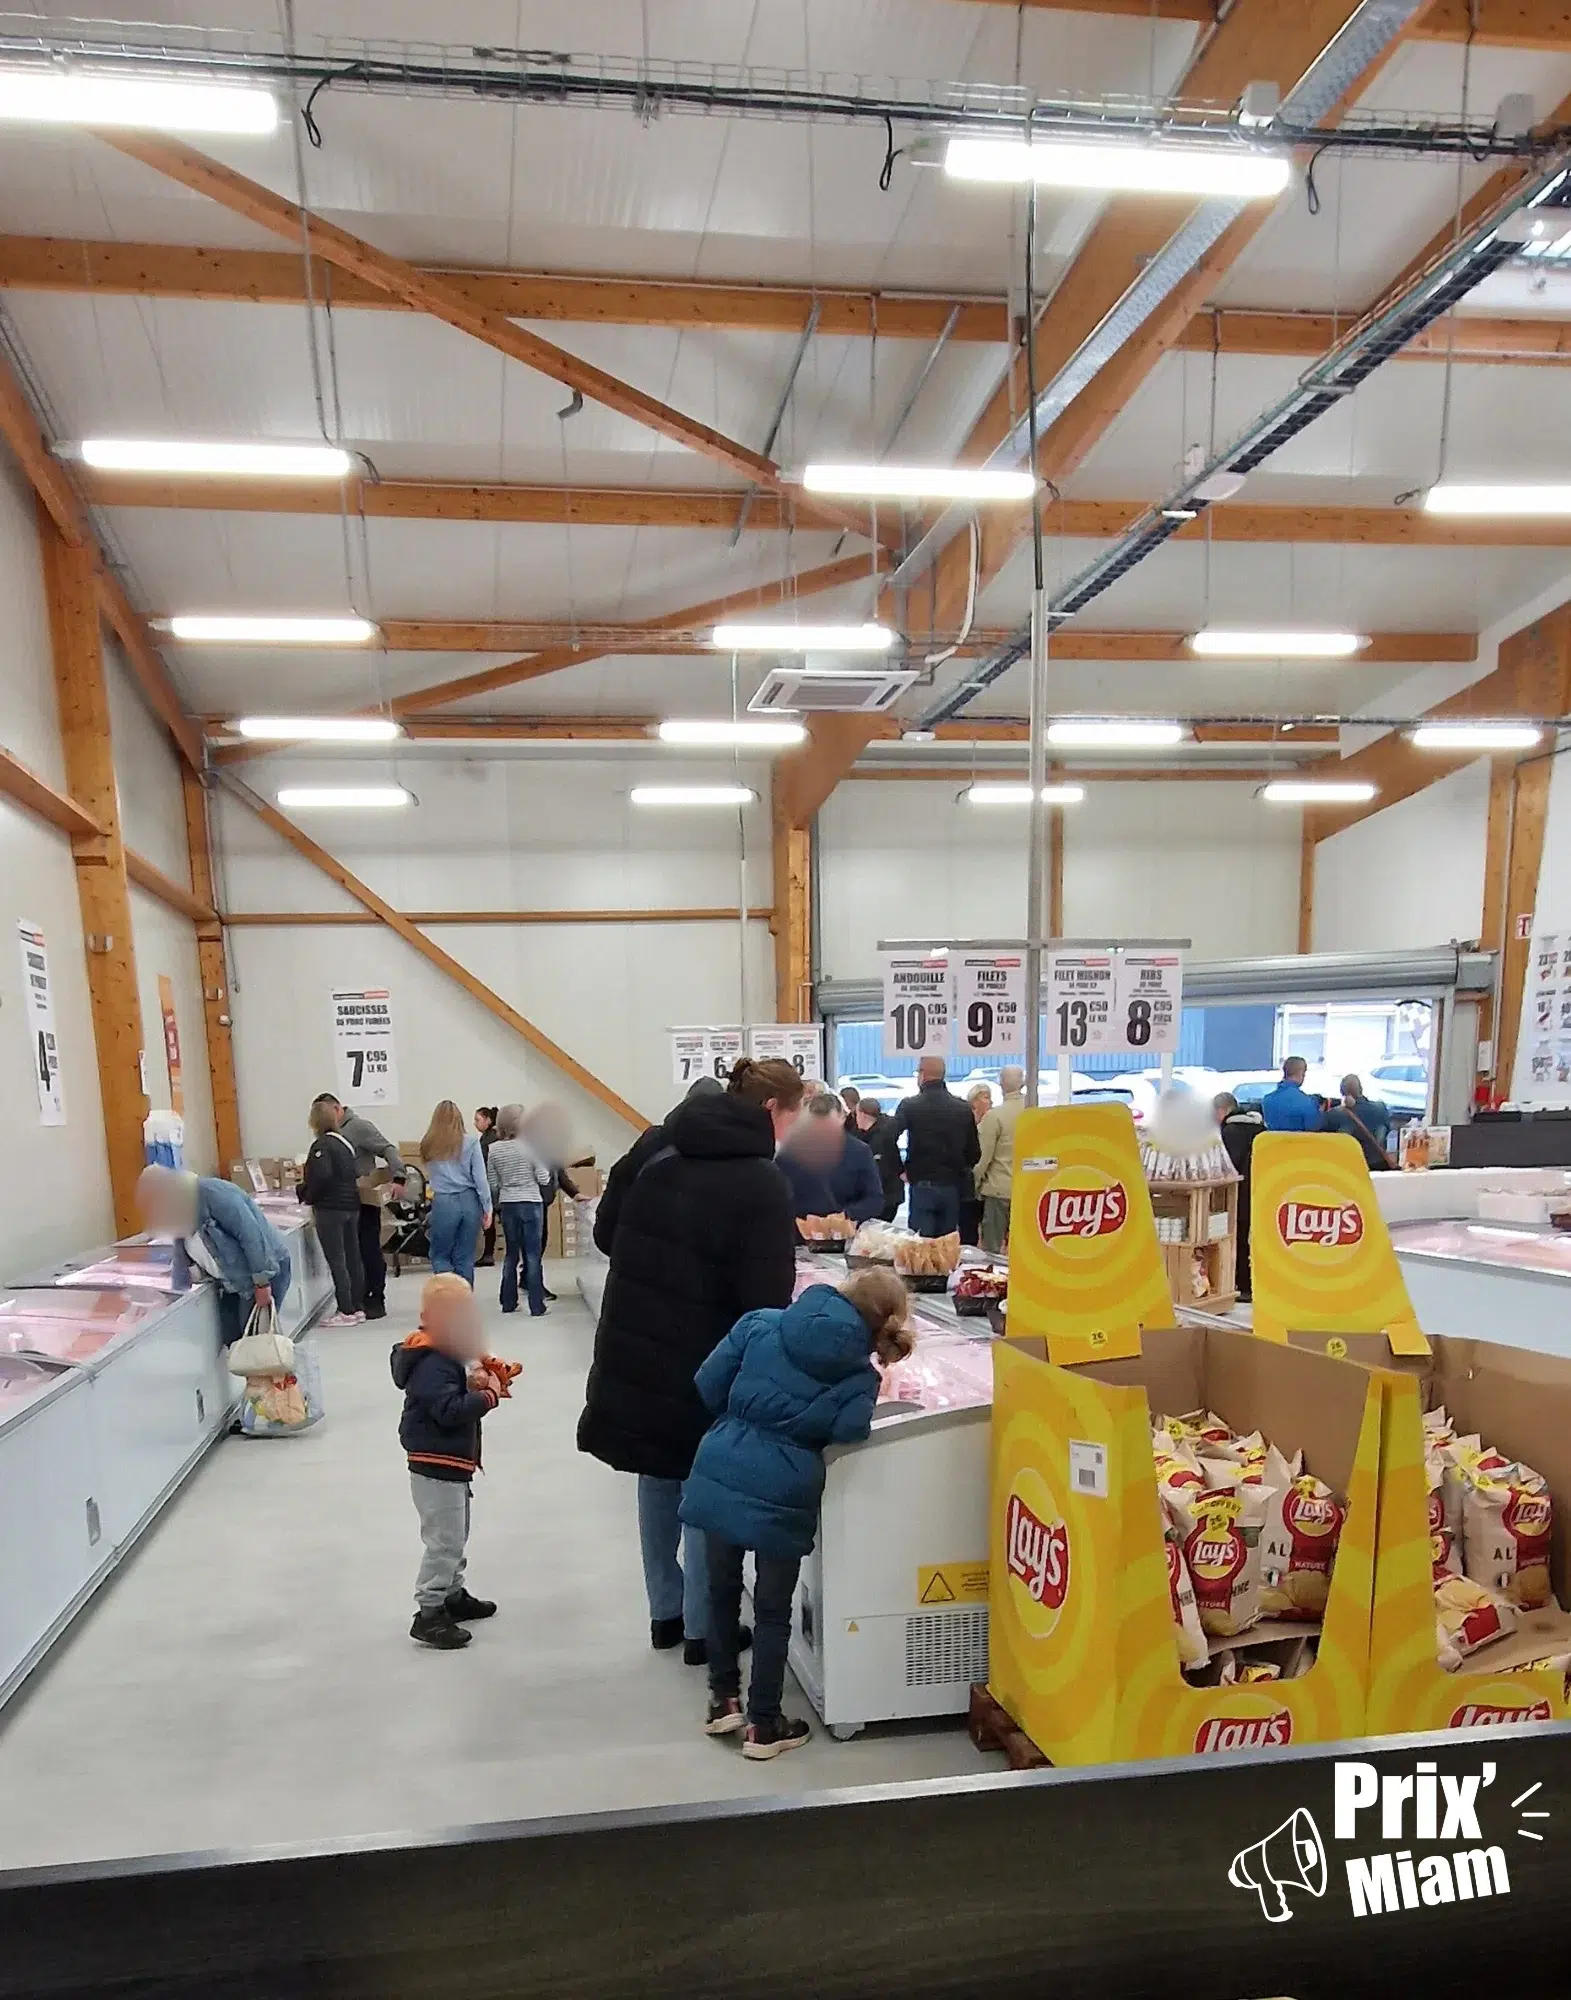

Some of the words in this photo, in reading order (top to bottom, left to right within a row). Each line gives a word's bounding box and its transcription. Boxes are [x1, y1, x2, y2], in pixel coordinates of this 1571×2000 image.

[893, 972, 945, 984] ANDOUILLE
[977, 971, 1007, 982] FILETS
[1054, 970, 1074, 981] FILET
[1076, 970, 1111, 981] MIGNON
[1140, 969, 1162, 980] RIBS
[337, 1004, 388, 1016] SAUCISSES
[997, 1015, 1004, 1024] LE
[1005, 1015, 1016, 1024] KG
[890, 1003, 926, 1050] 10
[967, 1001, 993, 1048] 9
[1056, 1000, 1088, 1047] 13
[1126, 1000, 1151, 1046] 8
[346, 1050, 364, 1088] 7
[367, 1064, 375, 1073] LE
[680, 1058, 691, 1080] 7
[714, 1056, 727, 1079] 6
[1046, 1187, 1122, 1239] Lay's
[1286, 1204, 1357, 1247] Lay's
[1009, 1499, 1065, 1601] Lay's
[1193, 1541, 1235, 1567] Lay's
